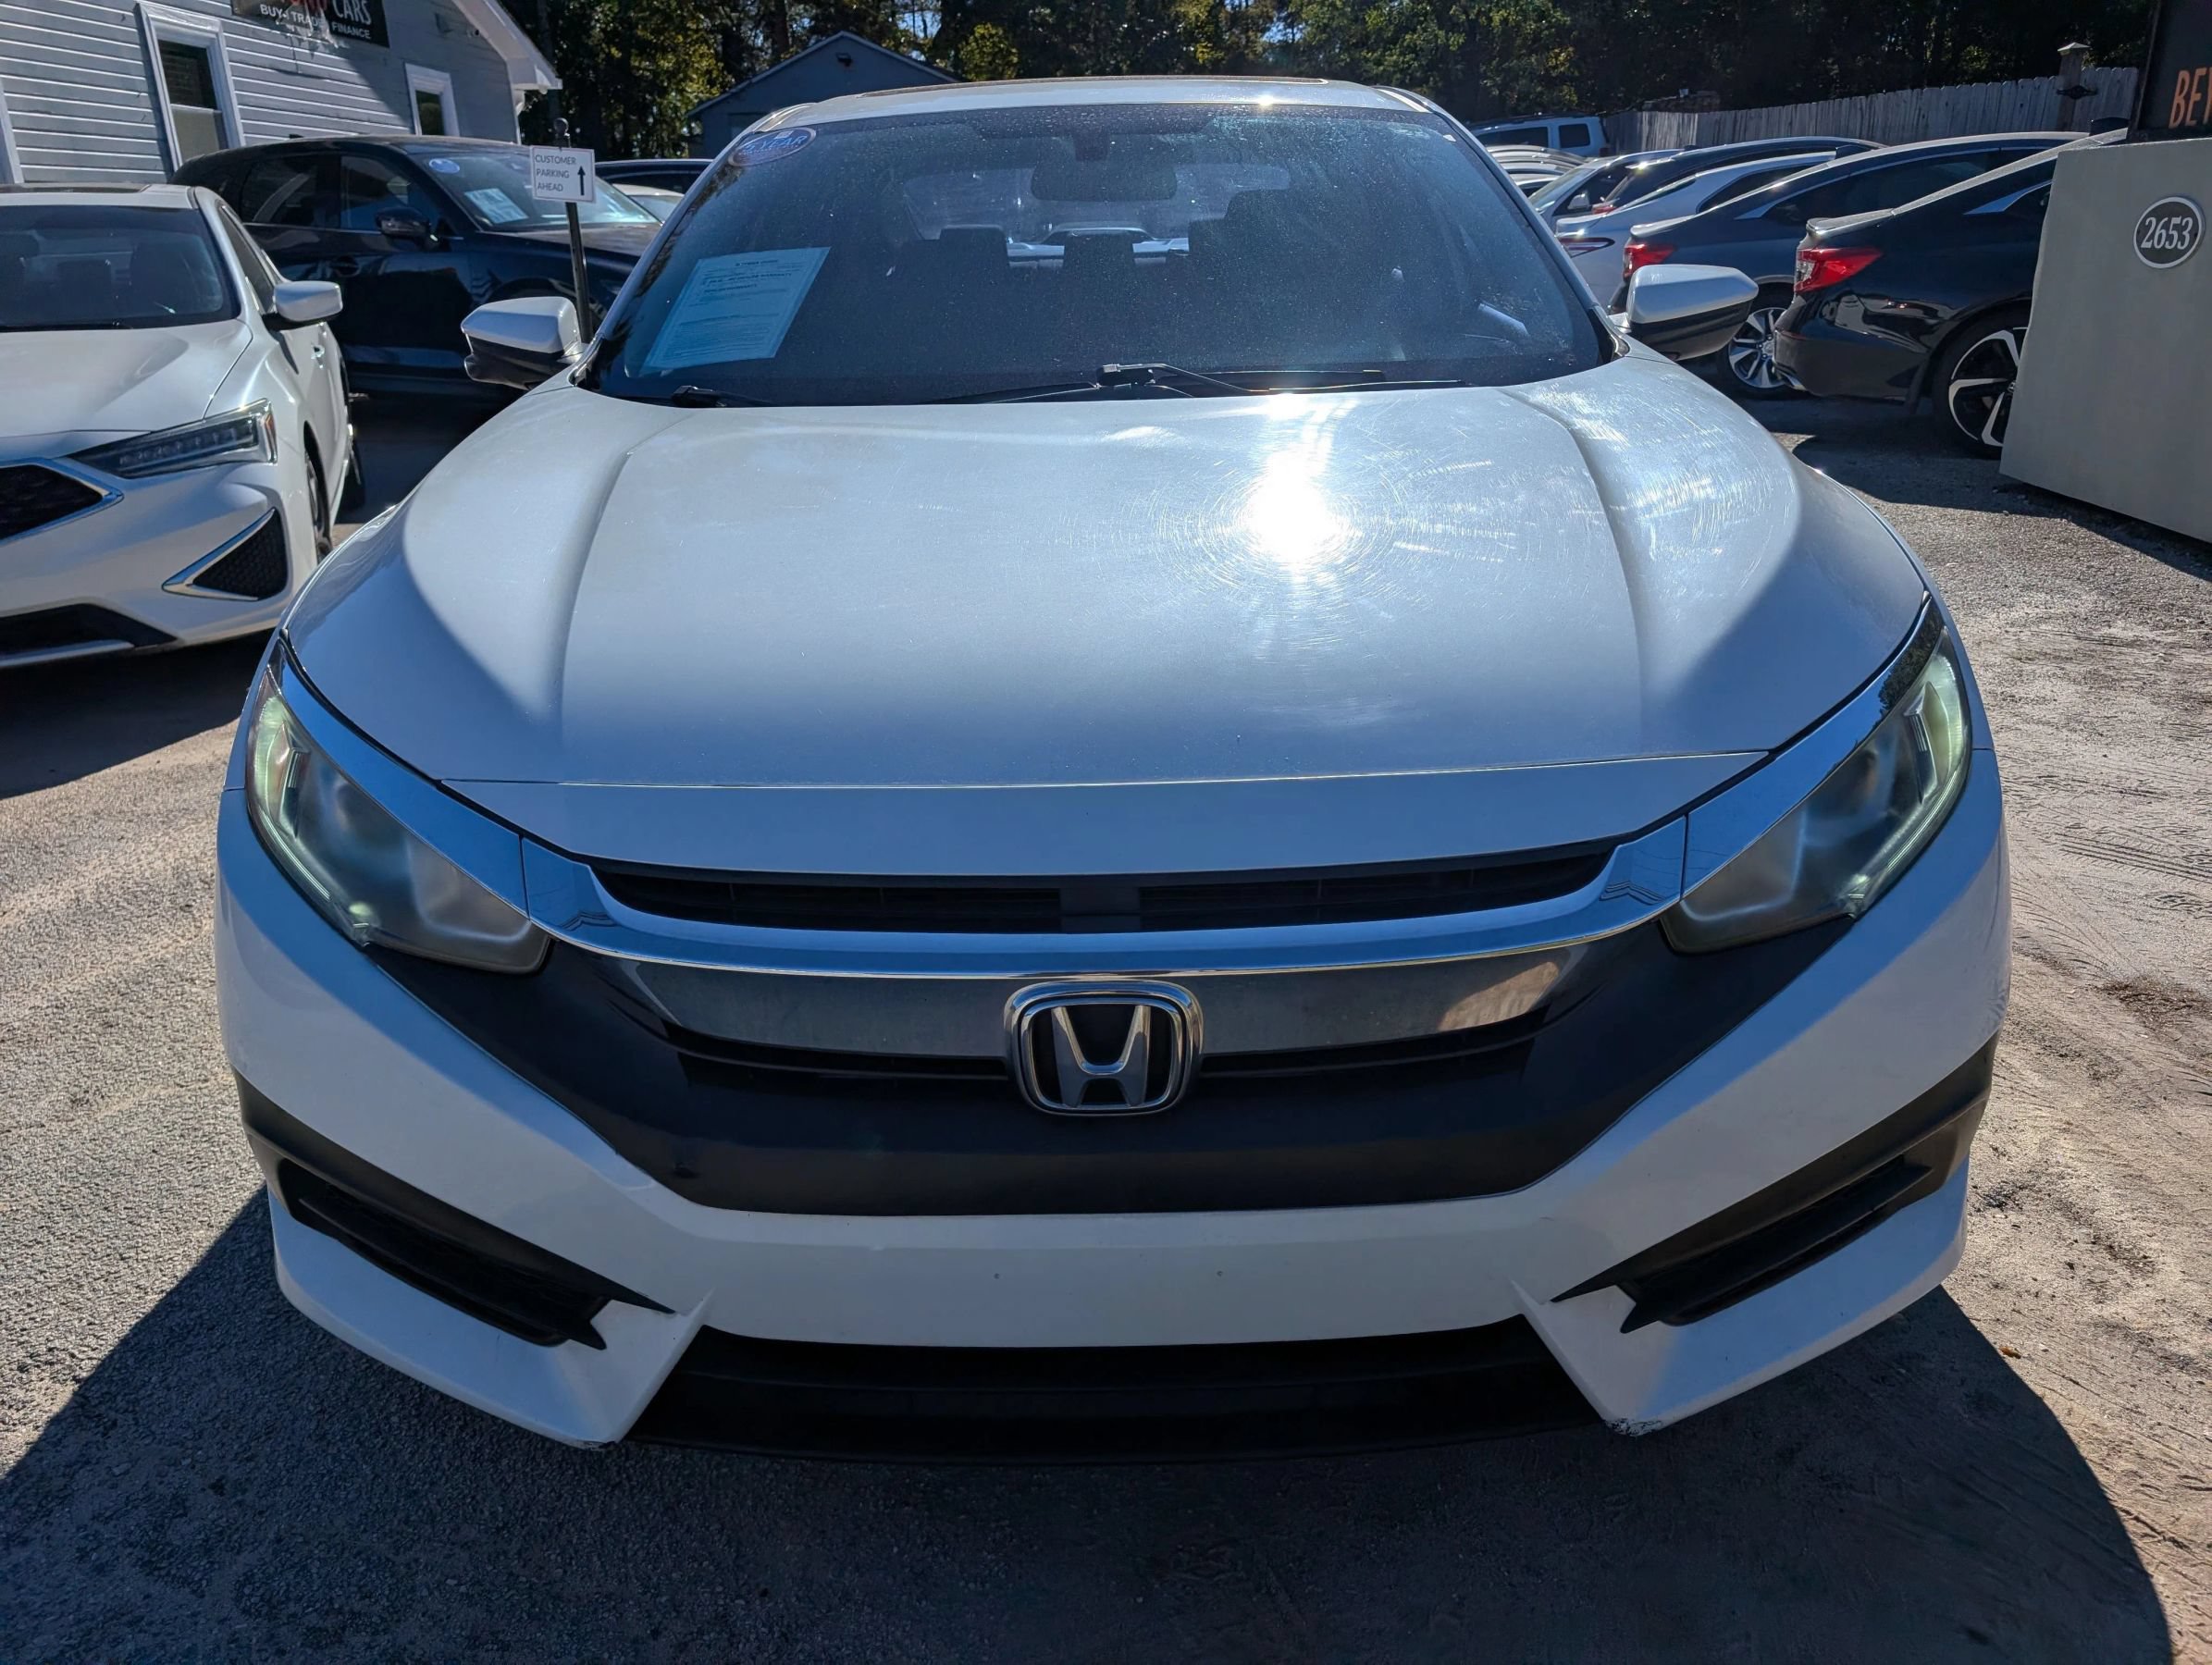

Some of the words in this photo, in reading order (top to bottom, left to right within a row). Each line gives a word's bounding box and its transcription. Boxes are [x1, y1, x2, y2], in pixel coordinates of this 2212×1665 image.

[260, 4, 283, 18] BUY
[331, 23, 371, 40] FINANCE
[535, 154, 576, 165] CUSTOMER
[537, 168, 570, 179] PARKING
[538, 182, 563, 191] AHEAD
[2140, 216, 2193, 250] 2653
